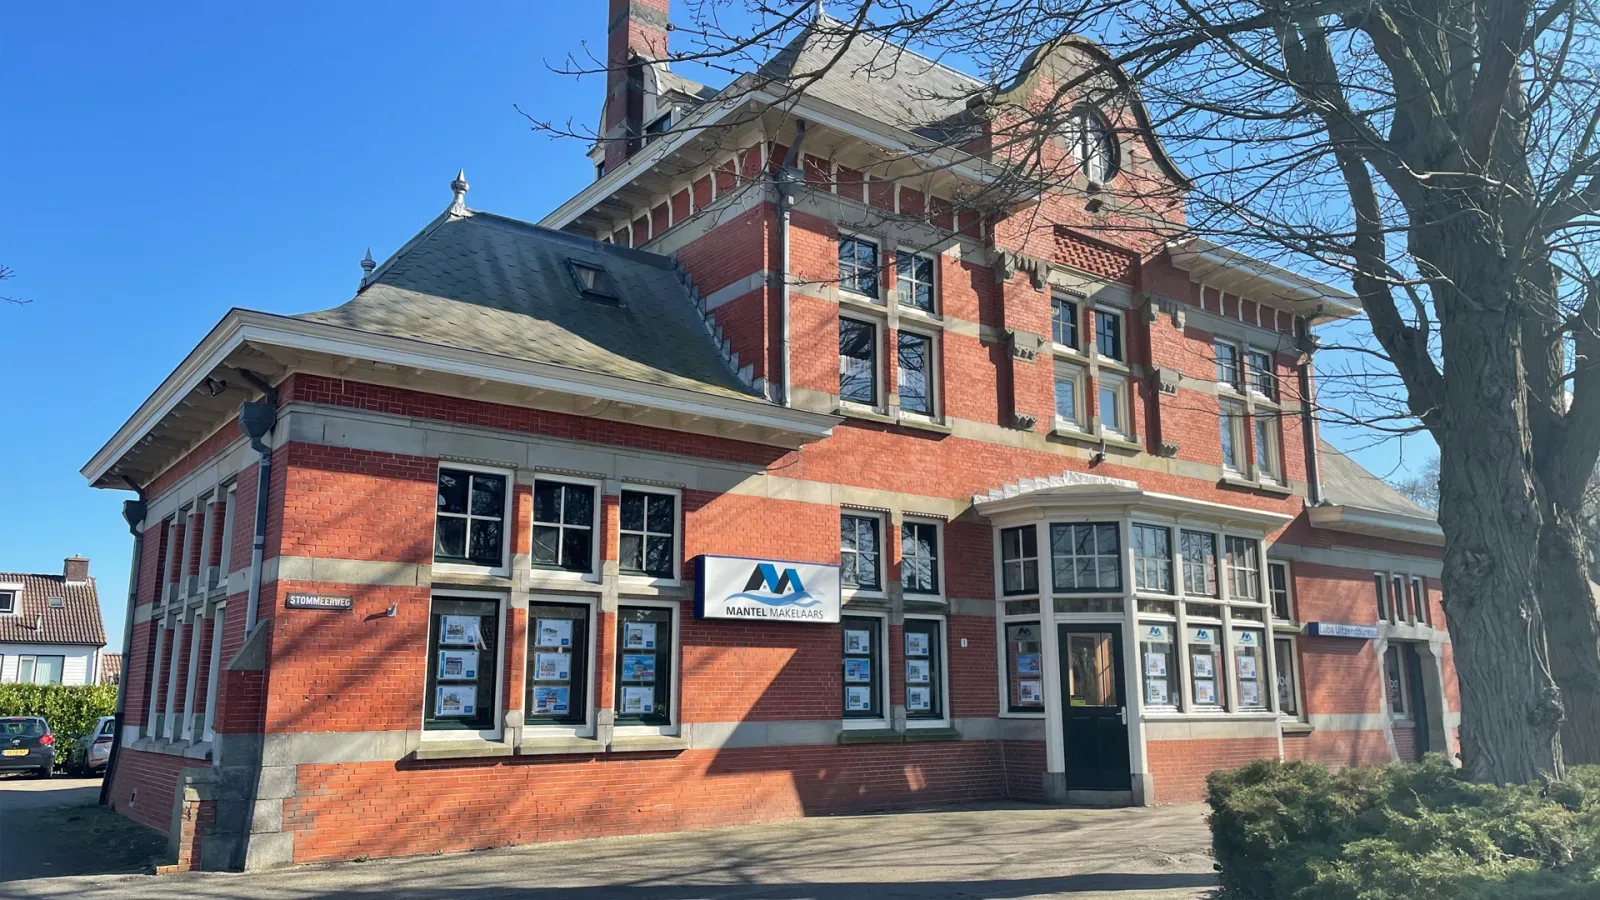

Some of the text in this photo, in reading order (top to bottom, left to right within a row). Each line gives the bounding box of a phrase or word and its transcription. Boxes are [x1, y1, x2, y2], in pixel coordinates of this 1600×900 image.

[290, 595, 351, 607] STOMMEERWEG
[726, 606, 824, 620] MANTEL MAKELAARS
[1320, 624, 1334, 635] Luba
